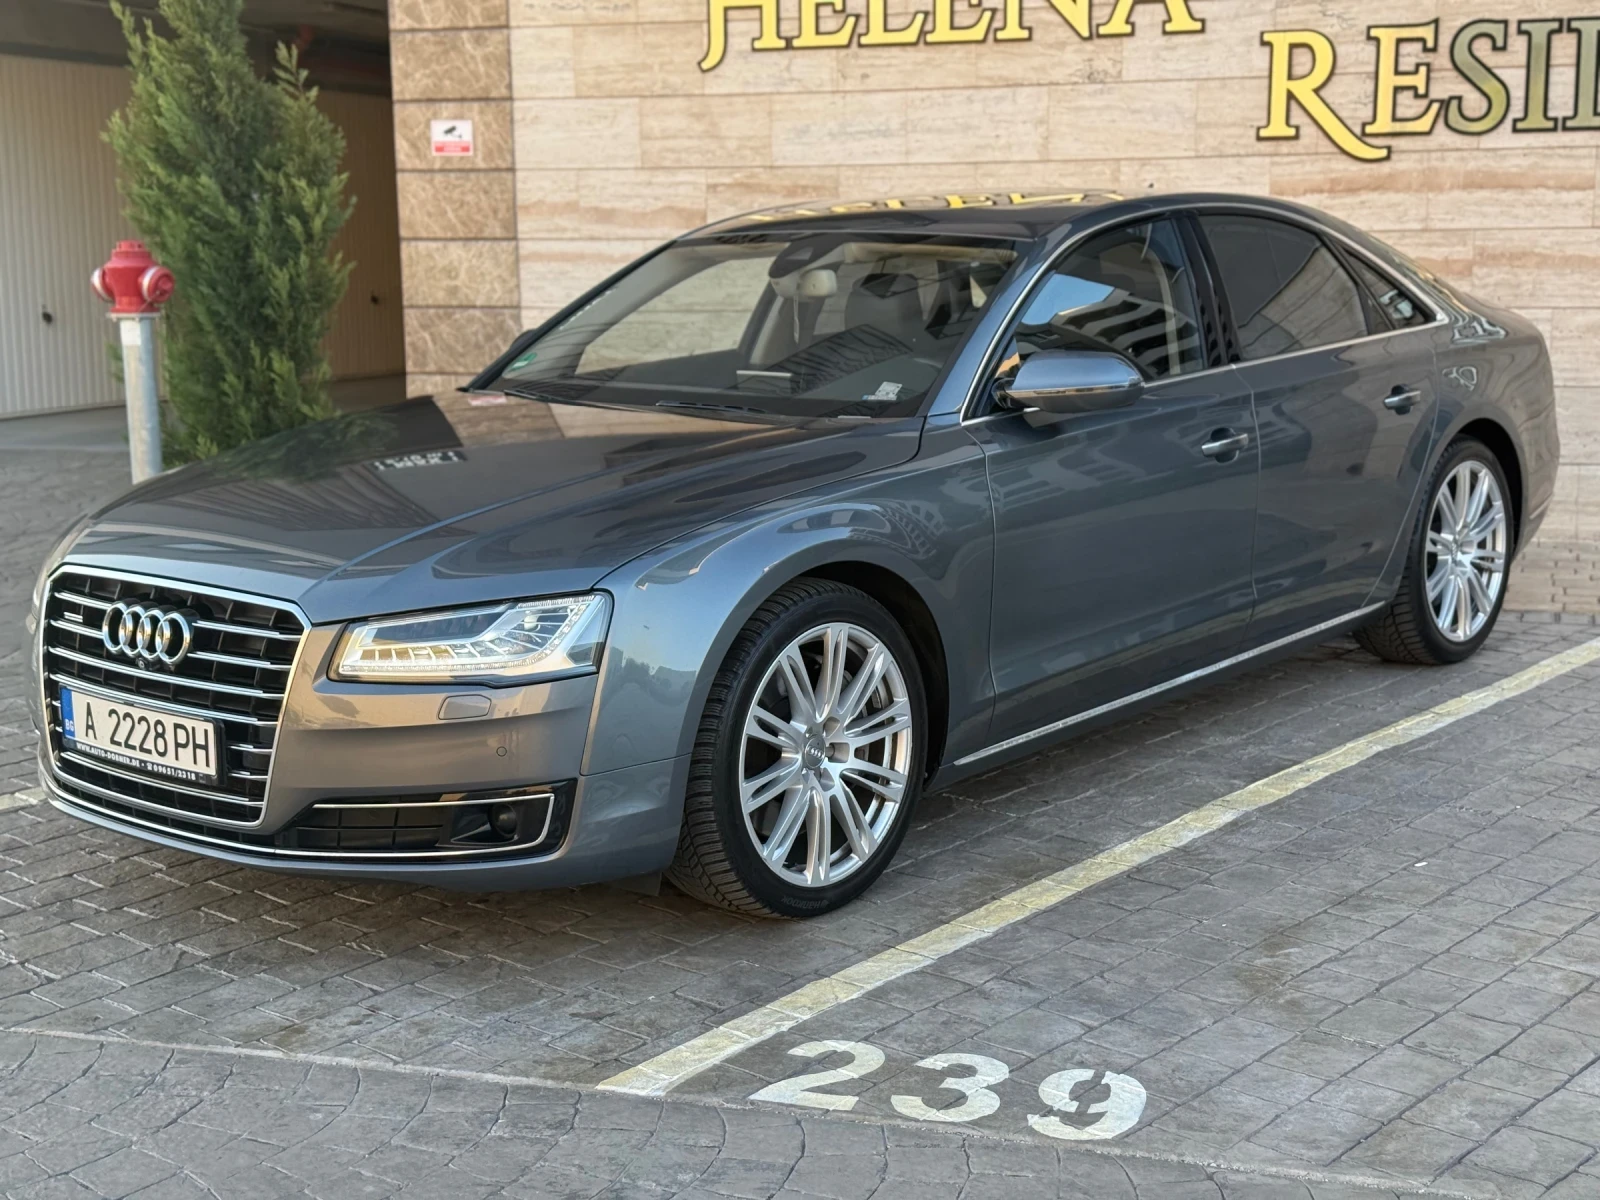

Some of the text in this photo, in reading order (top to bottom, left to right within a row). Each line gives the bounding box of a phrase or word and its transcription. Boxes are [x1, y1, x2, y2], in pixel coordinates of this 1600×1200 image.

[64, 718, 75, 732] BG
[85, 701, 211, 768] A 2228 PH
[747, 1039, 1148, 1141] 239
